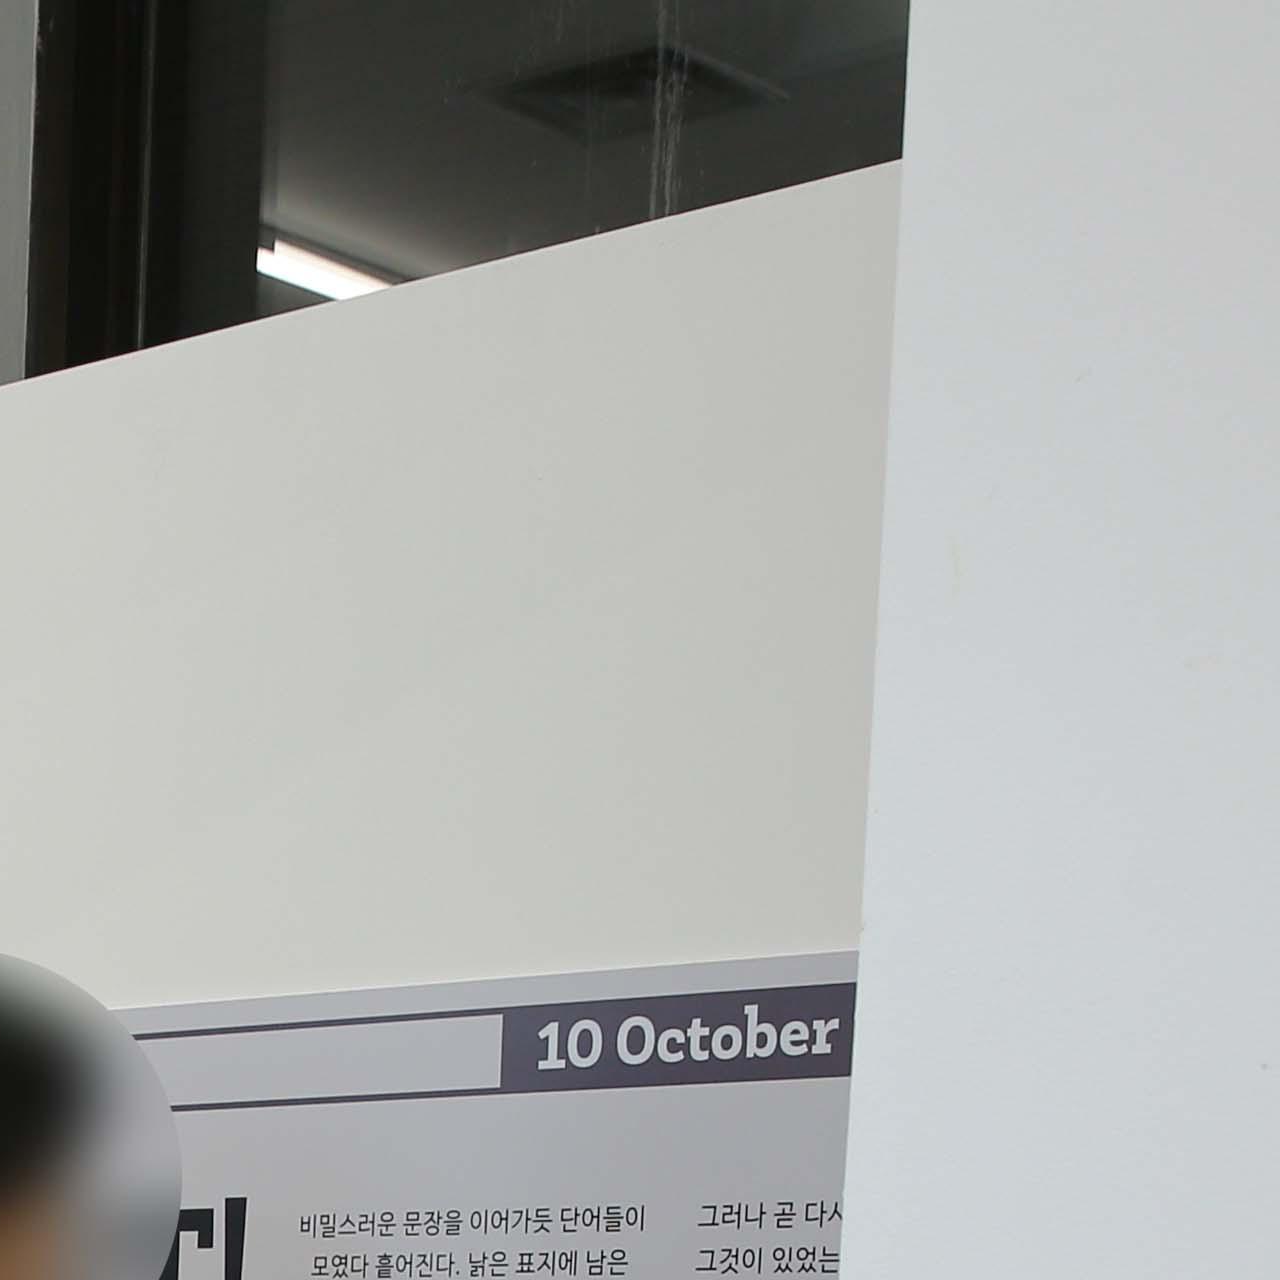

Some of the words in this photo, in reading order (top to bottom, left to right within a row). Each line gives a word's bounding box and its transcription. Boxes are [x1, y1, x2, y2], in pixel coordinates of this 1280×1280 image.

[538, 1019, 603, 1070] 10
[616, 1003, 840, 1066] October
[300, 1211, 397, 1239] 비밀스러운
[402, 1209, 464, 1237] 문장을
[470, 1207, 553, 1235] 이어가듯
[560, 1204, 645, 1233] 단어들이
[697, 1202, 767, 1230] 그러나
[773, 1201, 797, 1229] 곧
[311, 1254, 370, 1279] 모였다
[375, 1252, 460, 1279] 흩어진다.
[468, 1251, 509, 1278] 낡은
[515, 1250, 578, 1277] 표지에
[586, 1249, 629, 1276] 남은
[695, 1247, 762, 1275] 그것이
